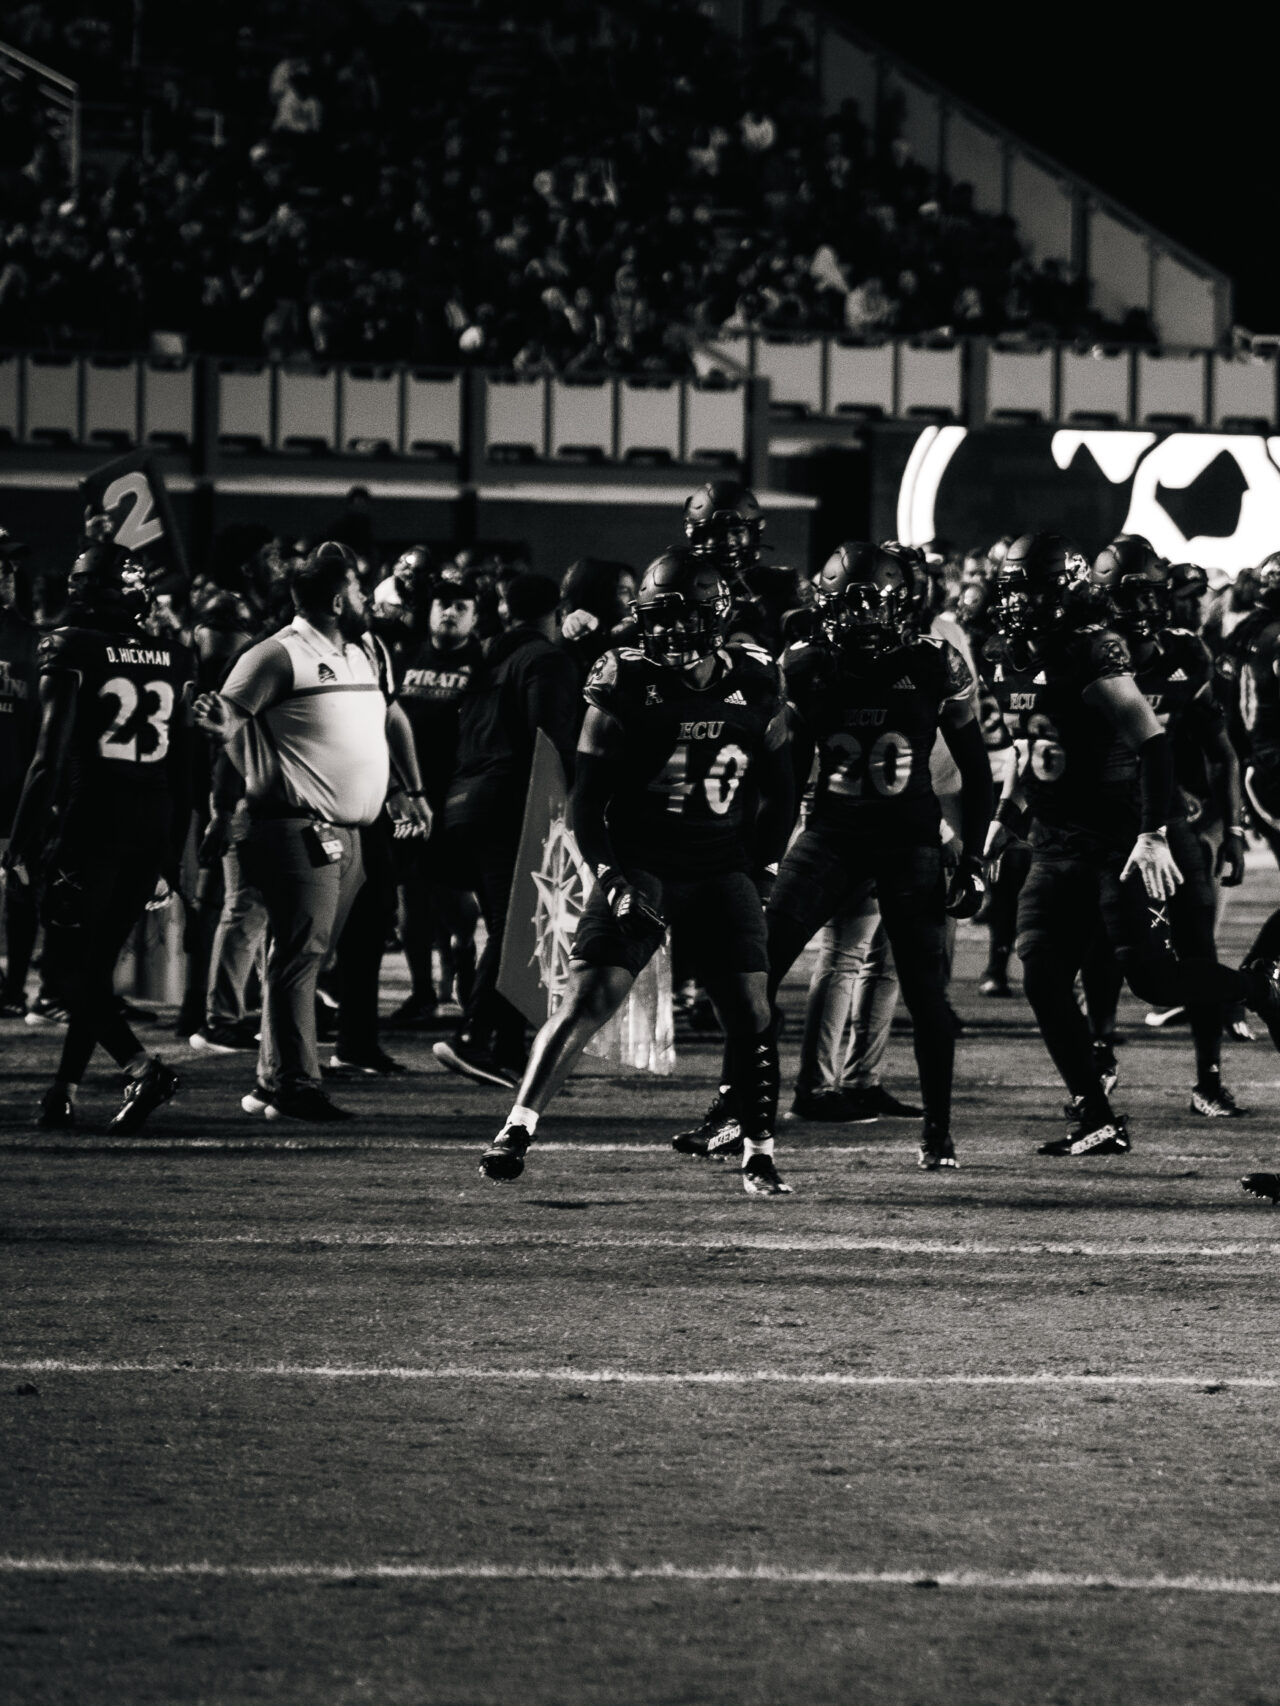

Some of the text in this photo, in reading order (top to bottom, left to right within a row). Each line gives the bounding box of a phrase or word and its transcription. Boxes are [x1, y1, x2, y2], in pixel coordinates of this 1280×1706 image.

[102, 471, 165, 551] 2
[97, 676, 175, 763] 23
[676, 721, 725, 740] ECU
[1009, 693, 1037, 710] ECU
[647, 744, 748, 815] 40
[826, 731, 913, 796] 20
